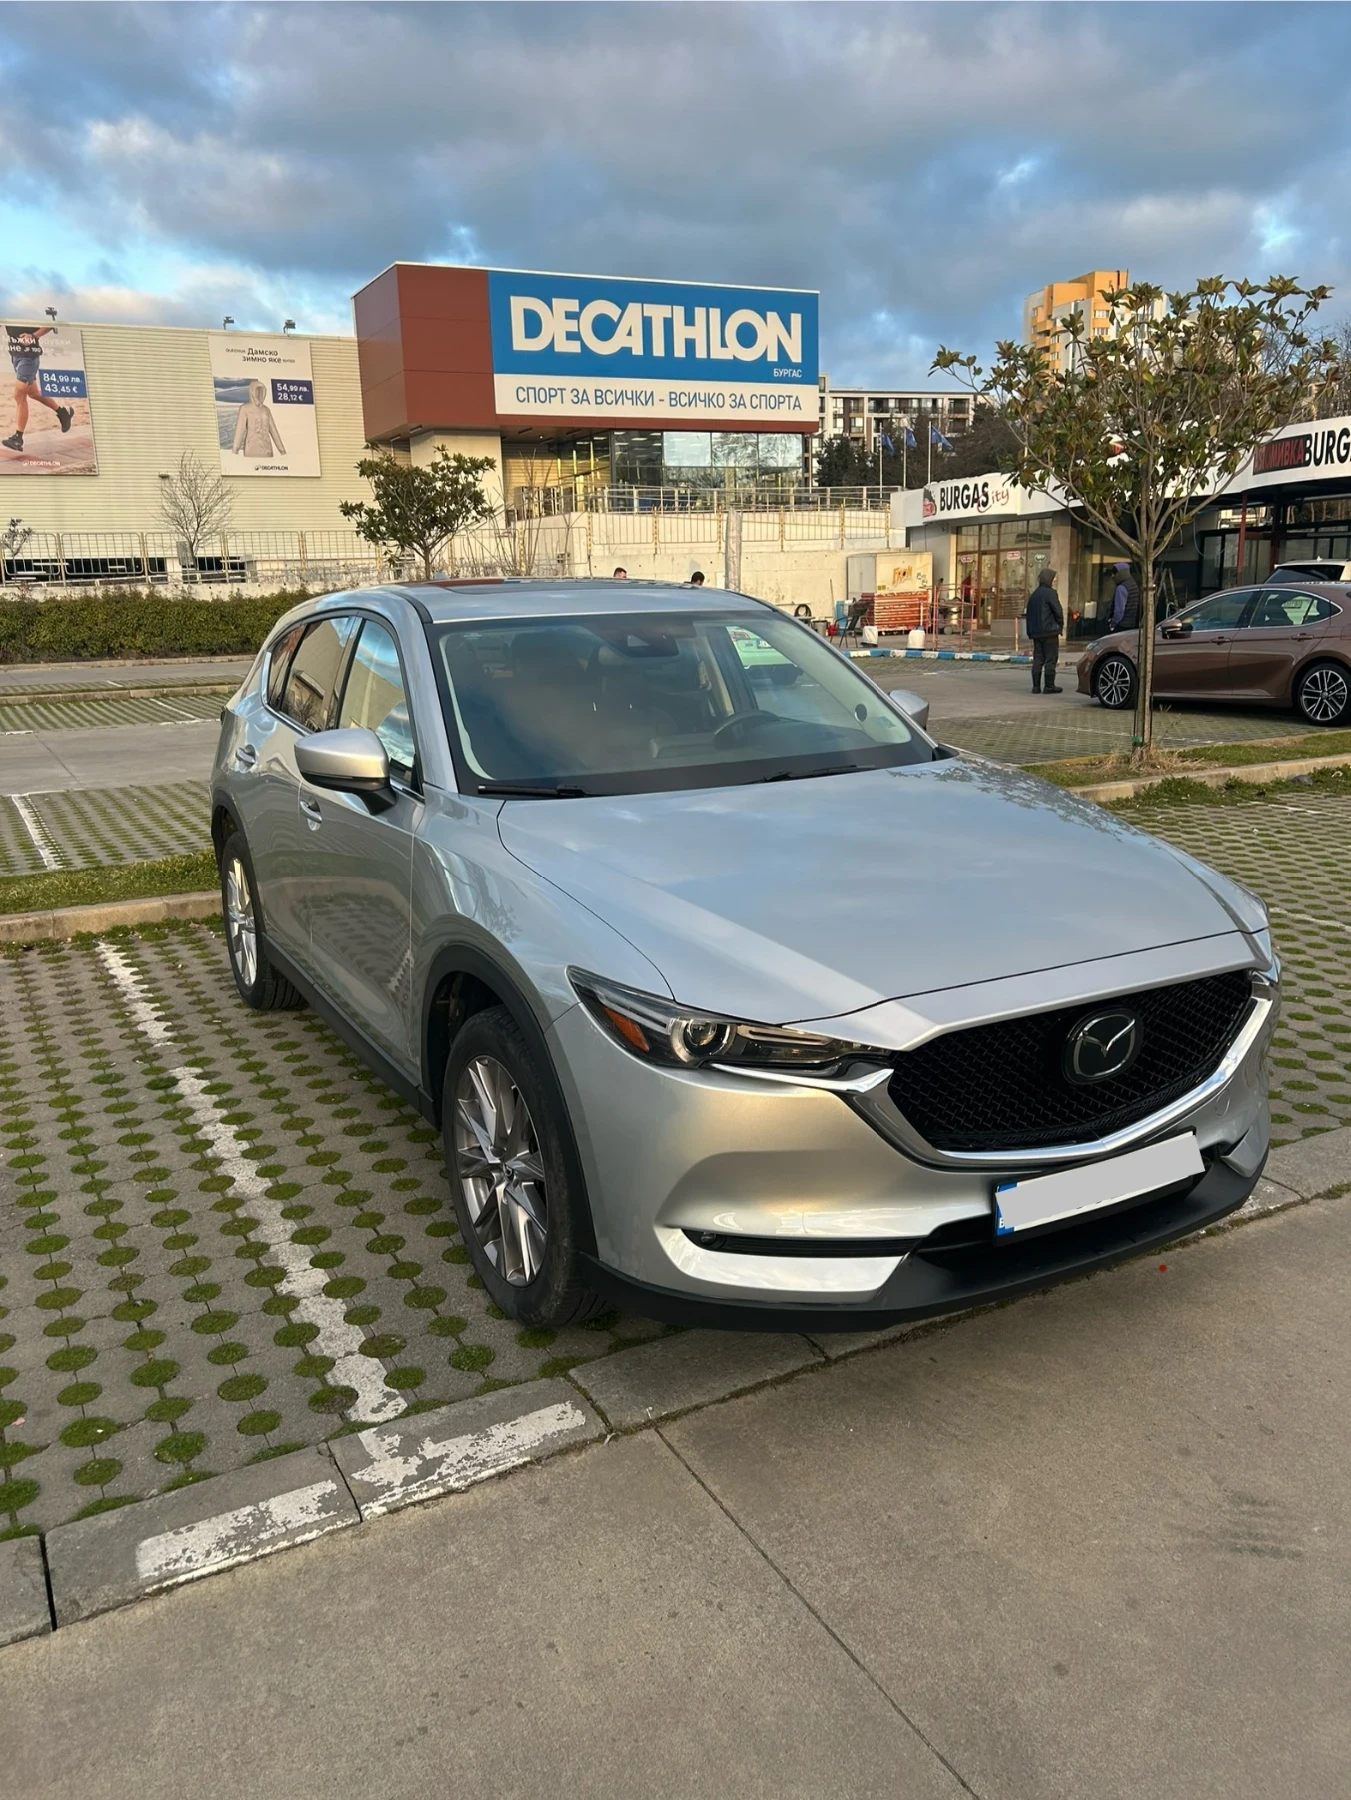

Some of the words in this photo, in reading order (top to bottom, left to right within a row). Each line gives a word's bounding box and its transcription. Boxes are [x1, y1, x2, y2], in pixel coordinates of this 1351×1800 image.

[510, 295, 802, 363] DECATHLON
[247, 347, 278, 356] Дамско
[43, 373, 69, 384] 84,99
[773, 368, 802, 378] БУРГАС
[44, 383, 71, 394] 43,45
[276, 383, 299, 392] 54,99
[278, 392, 297, 401] 28,12
[515, 385, 566, 404] СПОРТ
[570, 388, 591, 405] ЗА
[594, 388, 654, 407] ВСИЧКИ
[669, 391, 725, 409] ВСИЧКО
[728, 392, 747, 410] ЗА
[750, 394, 802, 411] СПОРТА
[1305, 427, 1351, 467] BURG
[940, 482, 989, 511] BURGAS
[977, 488, 1010, 513] City
